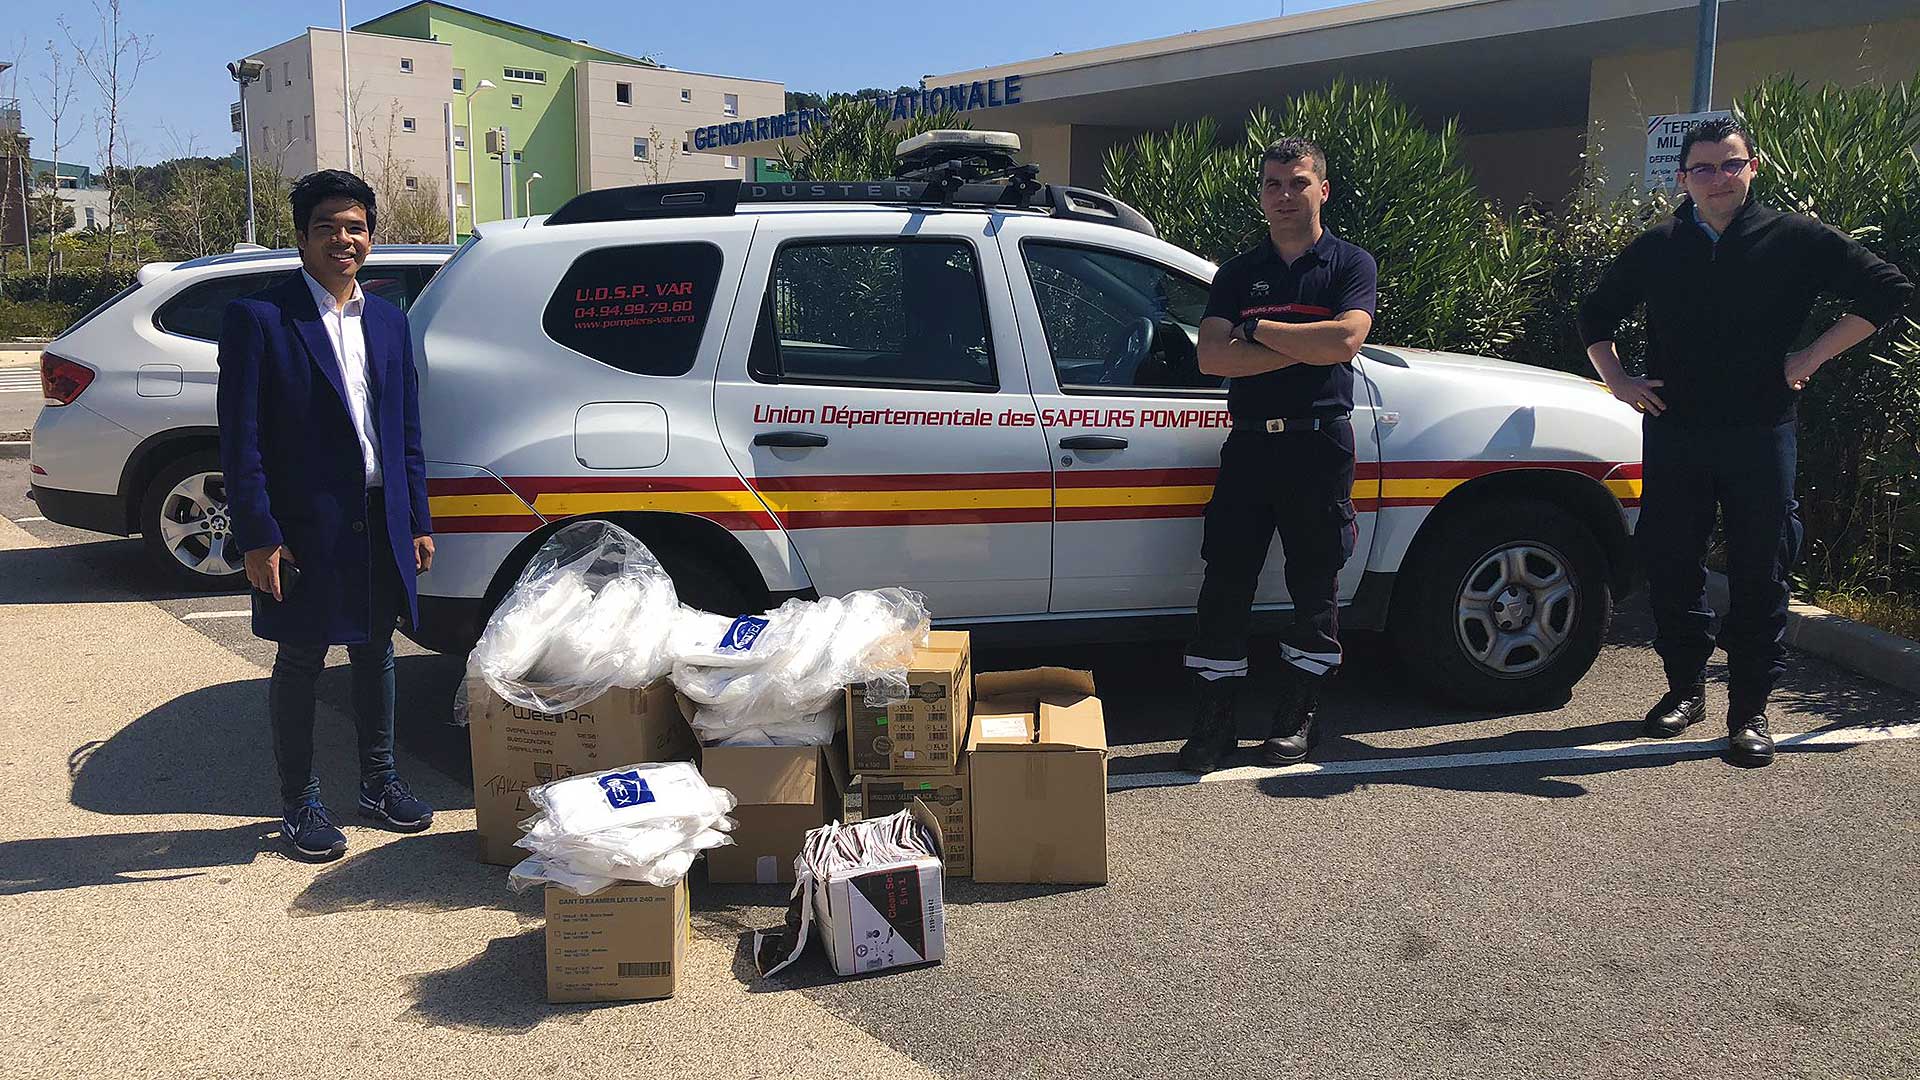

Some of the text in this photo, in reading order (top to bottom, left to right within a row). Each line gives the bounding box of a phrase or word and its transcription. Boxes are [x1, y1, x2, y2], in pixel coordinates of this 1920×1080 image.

[875, 74, 1021, 121] NATIONALE
[752, 184, 913, 198] DUSTER
[575, 282, 694, 301] U.D.S.P. VAR
[575, 300, 693, 318] 04.94.99.79.60
[574, 315, 695, 329] www.pompiers-var.org
[753, 404, 815, 424] Union
[820, 404, 993, 429] Départementale
[998, 409, 1035, 427] des
[1041, 409, 1135, 428] SAPEURS
[515, 796, 527, 811] L
